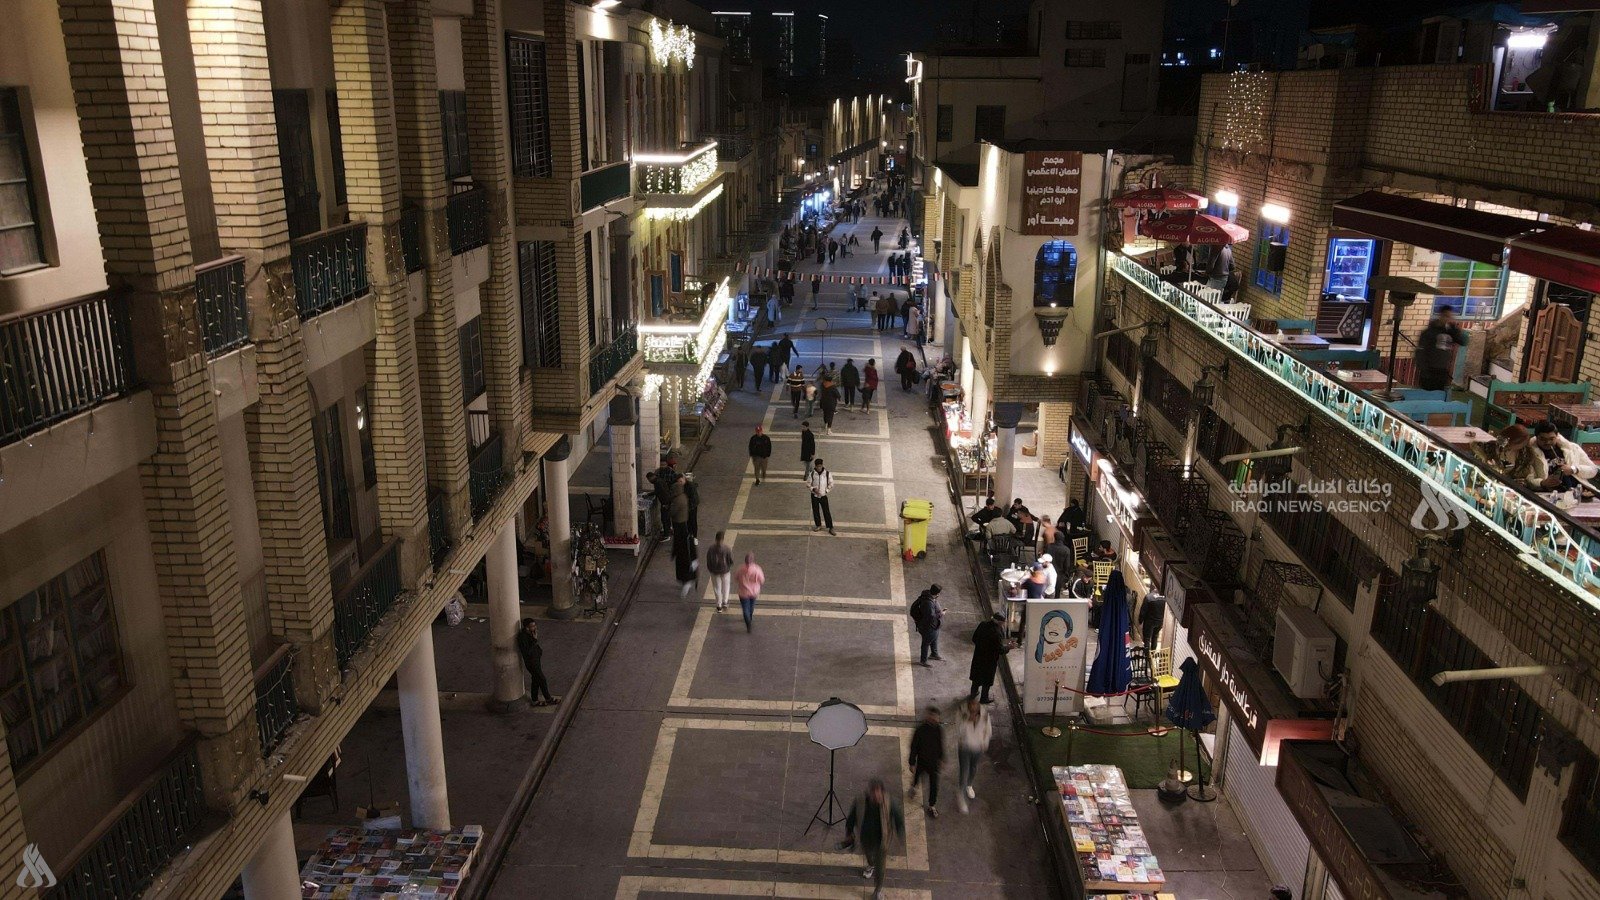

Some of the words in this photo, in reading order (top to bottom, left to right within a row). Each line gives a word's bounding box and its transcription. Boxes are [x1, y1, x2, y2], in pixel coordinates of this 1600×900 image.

[1042, 156, 1064, 166] مجمع
[1059, 167, 1080, 177] نعمان
[1055, 185, 1078, 195] مطبعة
[1054, 196, 1065, 205] ابو
[1027, 213, 1039, 226] أور
